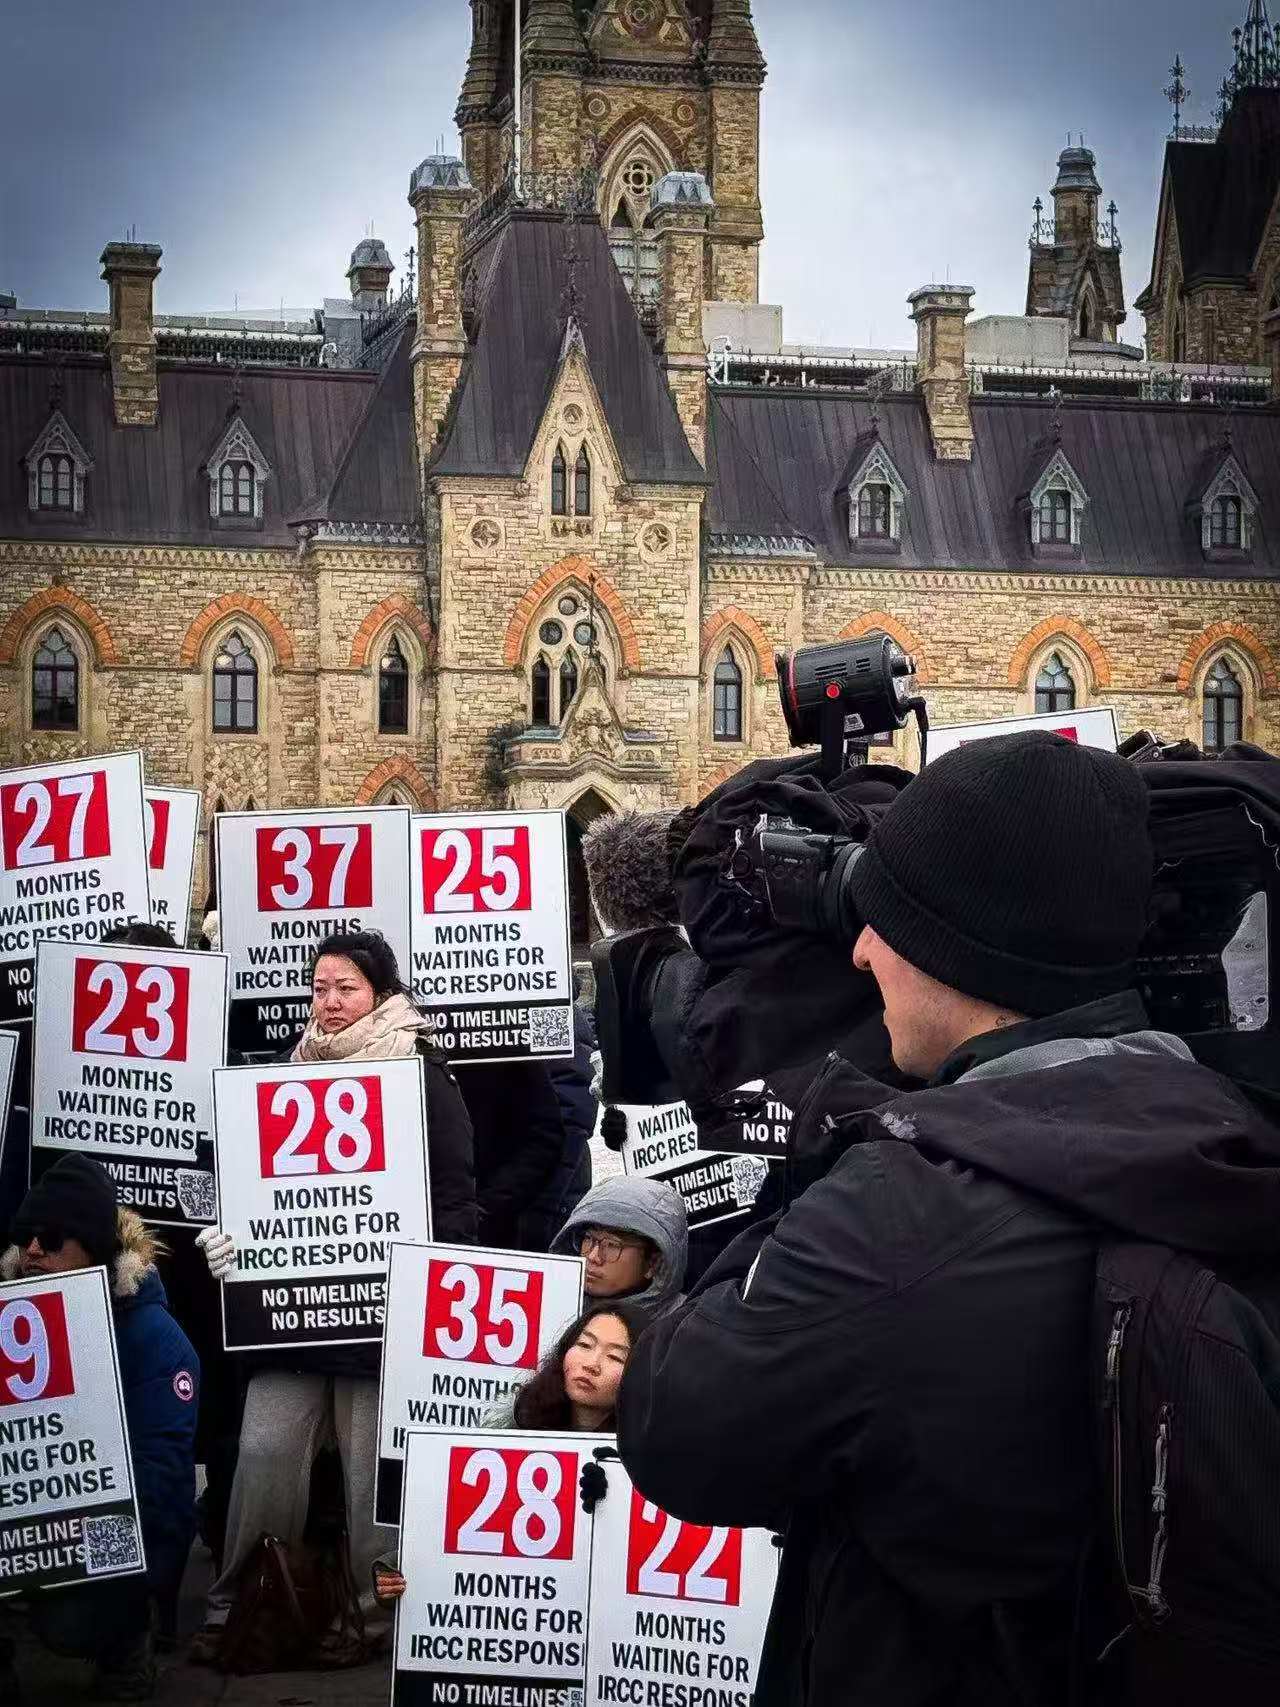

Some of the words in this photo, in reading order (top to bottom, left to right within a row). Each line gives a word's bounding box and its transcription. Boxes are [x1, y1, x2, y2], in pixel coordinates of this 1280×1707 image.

[14, 774, 94, 866] 27
[271, 827, 358, 910] 37
[432, 829, 520, 912] 25
[16, 869, 101, 899] MONTHS
[0, 898, 80, 927] WAITING
[86, 891, 125, 915] FOR
[271, 918, 361, 940] MONTHS
[435, 922, 521, 945] MONTHS
[247, 944, 318, 965] WAITIN
[413, 948, 499, 971] WAITING
[506, 946, 544, 967] FOR
[8, 967, 31, 986] NO
[235, 970, 282, 990] IRCC
[412, 976, 447, 996] RCC
[451, 971, 557, 994] RESPONSE
[84, 962, 175, 1058] 23
[257, 1005, 282, 1021] NO
[451, 1008, 530, 1027] TIMELINE
[265, 1024, 290, 1040] NO
[432, 1033, 455, 1049] NO
[460, 1029, 530, 1048] RESULTS
[81, 1065, 173, 1093] MONTHS
[58, 1090, 147, 1118] WAITING
[154, 1099, 196, 1123] FOR
[44, 1116, 91, 1141] IRCC
[270, 1078, 371, 1175] 28
[637, 1107, 691, 1140] WAITIN
[743, 1122, 769, 1142] NO
[633, 1141, 667, 1170] IRCC
[673, 1161, 732, 1193] TIMELINE
[273, 1184, 373, 1211] MONTHS
[684, 1183, 736, 1213] RESULTS
[249, 1214, 348, 1241] WAITING
[355, 1211, 400, 1235] FOR
[236, 1246, 289, 1270] IRCC
[293, 1240, 390, 1267] RESPON
[262, 1287, 289, 1308] NO
[272, 1310, 299, 1330] NO
[304, 1305, 385, 1328] RESULTS
[434, 1263, 529, 1366] 35
[0, 1412, 64, 1445] NTHS
[407, 1400, 482, 1427] WAITIN
[45, 1439, 96, 1468] FOR
[0, 1467, 116, 1508] ESPONSE
[457, 1449, 562, 1557] 28
[0, 1517, 84, 1550] MELINE
[454, 1572, 557, 1600] MONTHS
[427, 1603, 527, 1631] WAITING
[535, 1609, 583, 1634] FOR
[635, 1611, 726, 1645] MONTHS
[410, 1634, 463, 1660] IRCC
[467, 1637, 584, 1667] RESPONS
[611, 1642, 700, 1678] WAITING
[707, 1653, 749, 1683] FOR
[432, 1682, 459, 1704] NO
[597, 1675, 643, 1704] IRCC
[648, 1681, 756, 1707] RESPONS
